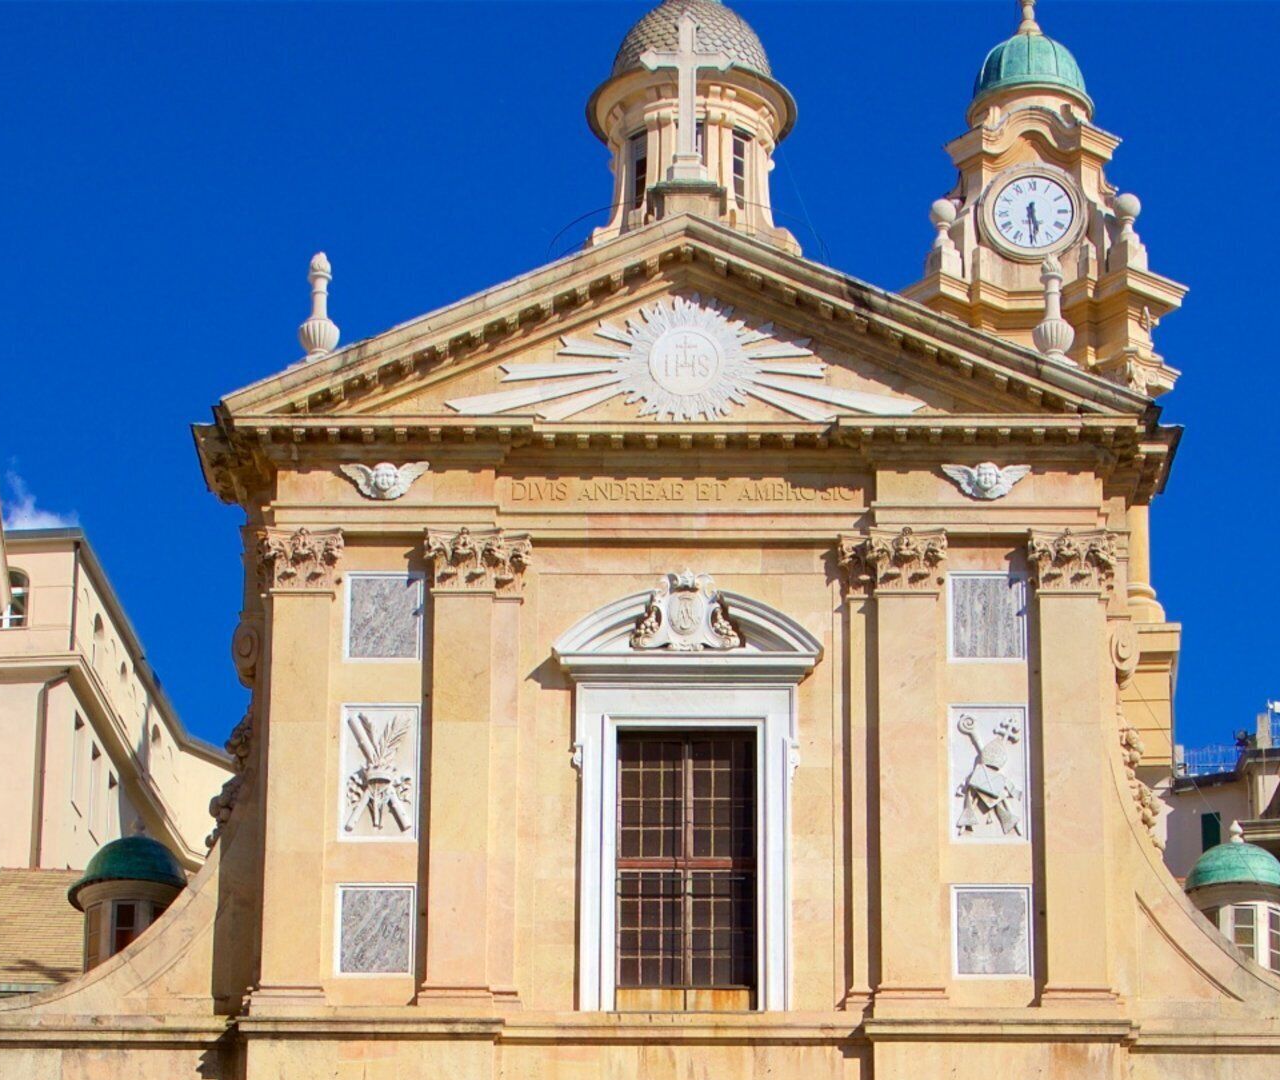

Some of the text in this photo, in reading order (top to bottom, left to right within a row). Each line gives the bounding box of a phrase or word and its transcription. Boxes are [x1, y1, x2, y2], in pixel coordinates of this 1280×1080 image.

[663, 353, 710, 378] IHS
[511, 481, 568, 501] DIVIS
[577, 481, 684, 501] ANDREAE
[696, 481, 726, 501] ET
